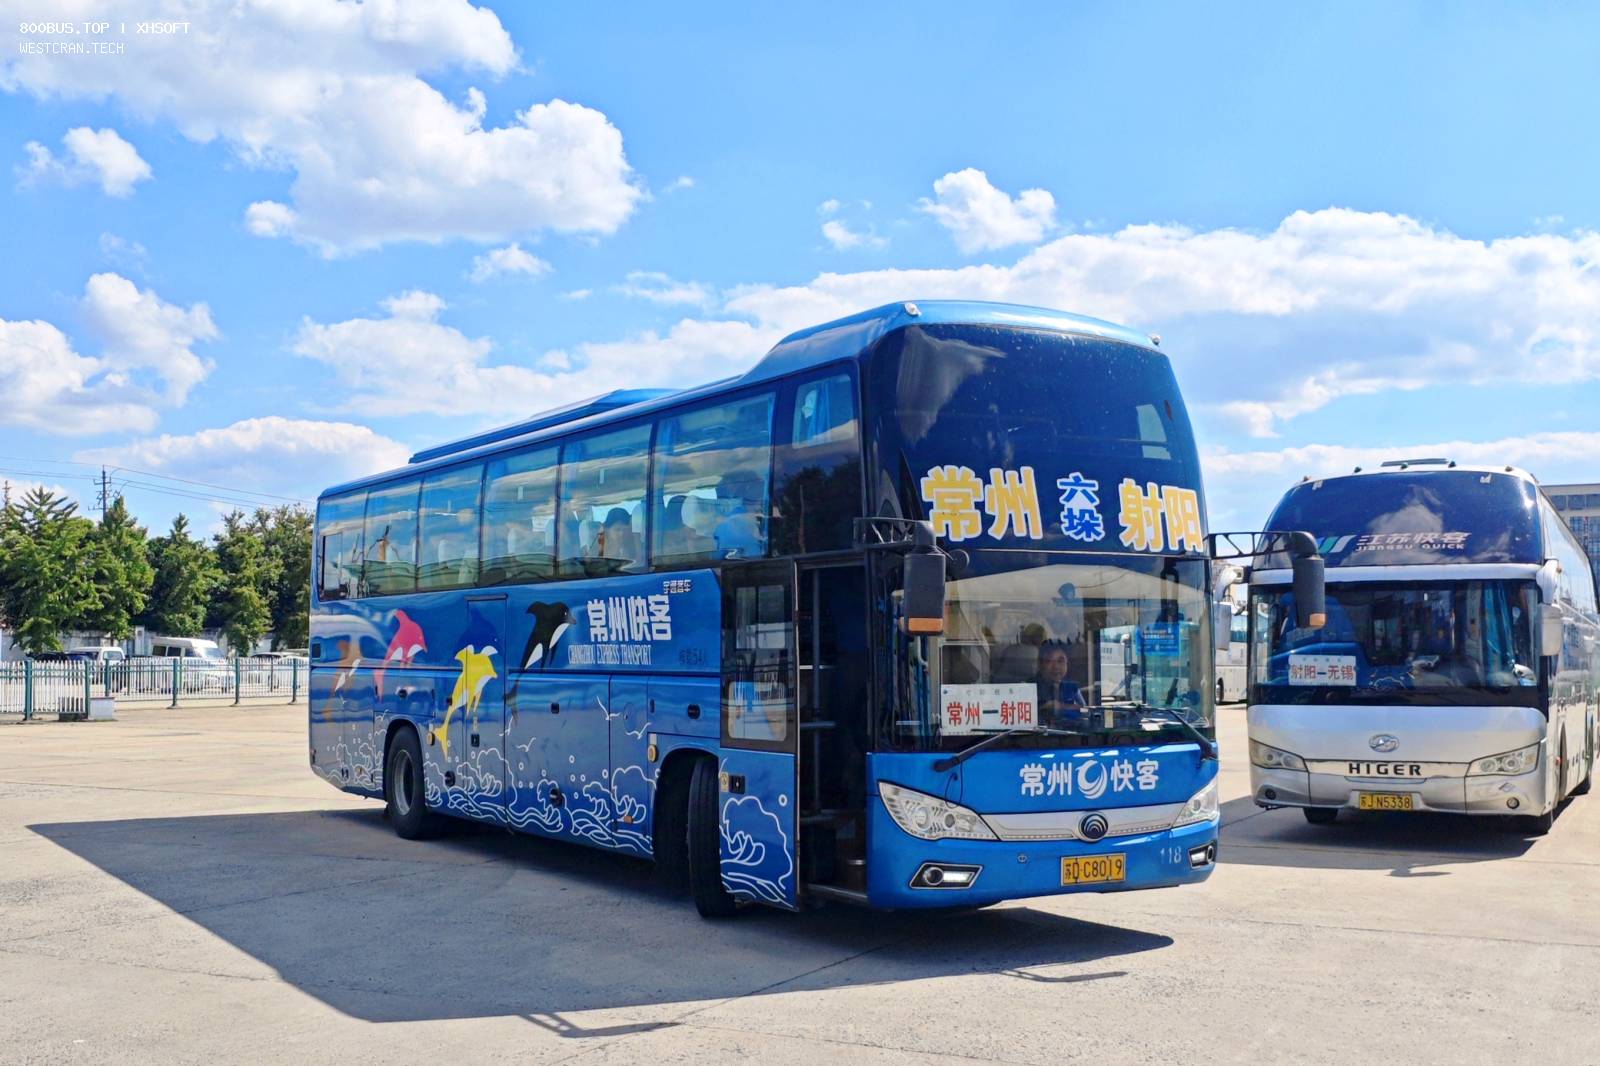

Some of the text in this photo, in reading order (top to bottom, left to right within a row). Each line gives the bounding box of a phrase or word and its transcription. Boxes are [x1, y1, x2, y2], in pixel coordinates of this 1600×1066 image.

[920, 465, 1203, 552] 常州 六垛 射阳
[1356, 532, 1472, 545] 江苏快客
[588, 594, 671, 641] 常州快客
[596, 643, 620, 665] EXPRESS
[620, 643, 652, 666] TRANSPORT
[1019, 758, 1159, 797] 常州 快客
[1348, 762, 1422, 776] HIGER
[1160, 847, 1182, 864] 118
